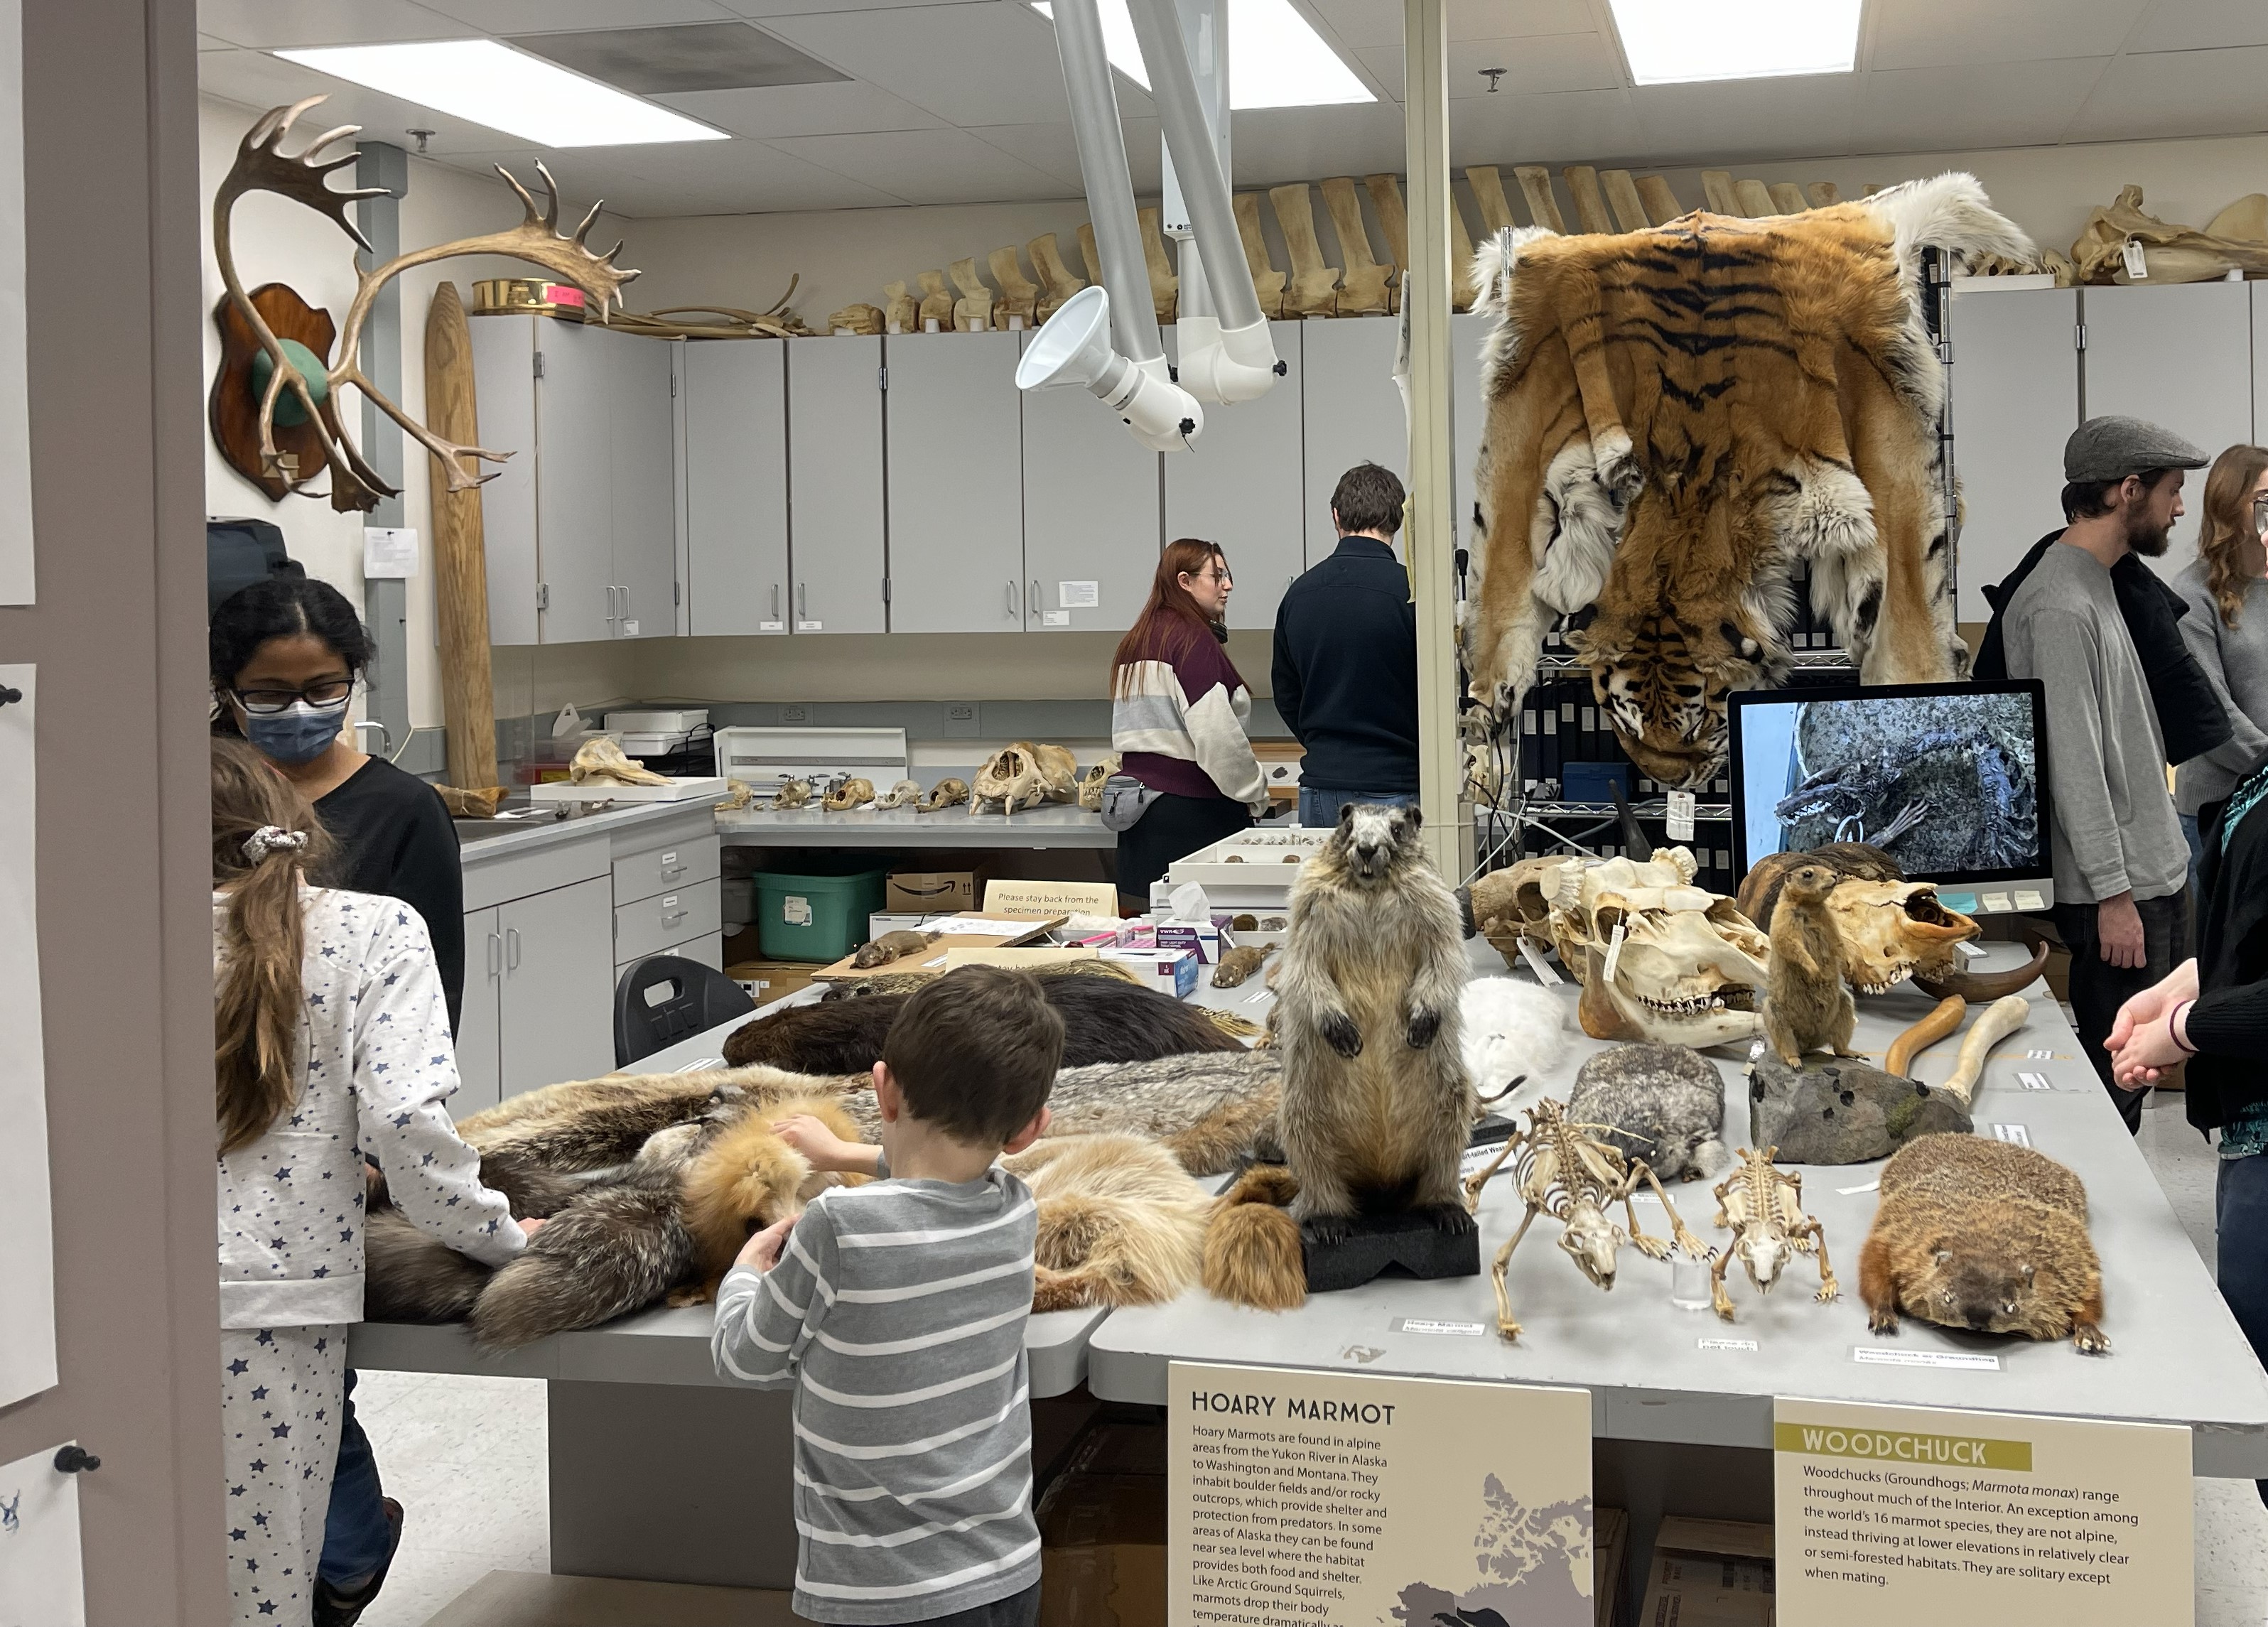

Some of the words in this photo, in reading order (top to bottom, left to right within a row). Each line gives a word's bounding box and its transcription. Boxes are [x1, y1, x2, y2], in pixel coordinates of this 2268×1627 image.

[1003, 907, 1042, 915] specimen
[1026, 895, 1042, 904] stay
[1192, 1391, 1275, 1416] HOARY
[1288, 1398, 1395, 1425] MARMOT
[1192, 1425, 1225, 1441] Hoary
[1227, 1427, 1276, 1442] Marmots
[1278, 1434, 1295, 1444] are
[1297, 1432, 1331, 1447] found
[1334, 1436, 1344, 1448] in
[1346, 1437, 1381, 1452] alpine
[1803, 1428, 1987, 1465] WOODCHUCK
[1192, 1444, 1221, 1454] areas
[1223, 1443, 1249, 1456] from
[1251, 1446, 1270, 1459] the
[1271, 1447, 1306, 1461] Yukon
[1309, 1451, 1336, 1464] River
[1339, 1453, 1349, 1465] in
[1351, 1454, 1388, 1468] Alaska
[1192, 1459, 1204, 1469] to
[1205, 1459, 1270, 1476] Washington
[1273, 1465, 1295, 1477] and
[1297, 1466, 1350, 1482] Montana.
[1351, 1470, 1379, 1487] They
[1803, 1464, 1881, 1483] Woodchucks
[1884, 1471, 1970, 1493] (Groundhogs;
[1972, 1479, 2029, 1495] Marmota
[2031, 1487, 2079, 1501] monax)
[2083, 1491, 2120, 1505] range
[1192, 1474, 1231, 1488] inhabit
[1233, 1477, 1277, 1492] boulder
[1278, 1481, 1308, 1495] fields
[1310, 1485, 1348, 1498] and/or
[1350, 1488, 1381, 1504] rocky
[1192, 1493, 1243, 1508] outcrops,
[1245, 1496, 1278, 1509] which
[1280, 1501, 1323, 1513] provide
[1325, 1502, 1364, 1517] shelter
[1366, 1506, 1387, 1518] and
[1803, 1484, 1875, 1503] throughout
[1877, 1493, 1913, 1506] much
[1916, 1495, 1929, 1508] of
[1930, 1496, 1953, 1510] the
[1955, 1498, 2004, 1514] Interior.
[2006, 1502, 2024, 1515] An
[2027, 1507, 2090, 1521] exception
[2093, 1512, 2139, 1528] among
[1192, 1510, 1249, 1523] protection
[1251, 1513, 1278, 1526] from
[1280, 1517, 1336, 1531] predators.
[1339, 1520, 1349, 1532] In
[1351, 1524, 1383, 1535] some
[1803, 1505, 1825, 1518] the
[1827, 1509, 1870, 1523] world's
[1874, 1512, 1889, 1524] 16
[1891, 1515, 1942, 1529] marmot
[1944, 1520, 1993, 1535] species,
[1995, 1522, 2024, 1539] they
[2026, 1527, 2047, 1538] are
[2050, 1529, 2072, 1540] not
[2075, 1528, 2117, 1545] alpine,
[1192, 1527, 1221, 1537] areas
[1223, 1527, 1236, 1539] of
[1236, 1528, 1272, 1542] Alaska
[1274, 1531, 1299, 1547] they
[1301, 1536, 1321, 1547] can
[1324, 1535, 1338, 1548] be
[1340, 1537, 1373, 1551] found
[1804, 1525, 1849, 1541] instead
[1852, 1530, 1900, 1548] thriving
[1903, 1536, 1916, 1547] at
[1918, 1535, 1953, 1550] lower
[1955, 1539, 2020, 1556] elevations
[2023, 1545, 2035, 1557] in
[2038, 1546, 2096, 1565] relatively
[2098, 1551, 2130, 1565] clear
[1192, 1543, 1217, 1554] near
[1219, 1546, 1237, 1556] sea
[1239, 1545, 1265, 1558] level
[1267, 1548, 1302, 1562] where
[1304, 1551, 1323, 1564] the
[1325, 1552, 1366, 1568] habitat
[1804, 1548, 1818, 1558] or
[1820, 1550, 1904, 1566] semi-forested
[1907, 1555, 1960, 1572] habitats.
[1961, 1560, 1993, 1577] They
[1996, 1566, 2016, 1577] are
[2019, 1565, 2066, 1584] solitary
[2068, 1572, 2111, 1586] except
[1192, 1560, 1239, 1573] provides
[1241, 1562, 1268, 1575] both
[1270, 1564, 1296, 1578] food
[1298, 1568, 1319, 1580] and
[1322, 1569, 1362, 1584] shelter.
[1804, 1566, 1839, 1581] when
[1842, 1572, 1889, 1588] mating.
[1192, 1574, 1214, 1587] Like
[1216, 1577, 1248, 1591] Arctic
[1250, 1580, 1292, 1594] Ground
[1295, 1584, 1345, 1601] Squirrels,
[1192, 1593, 1241, 1606] marmots
[1243, 1596, 1270, 1611] drop
[1272, 1599, 1298, 1612] their
[1300, 1601, 1329, 1618] body
[1192, 1609, 1261, 1626] temperature
